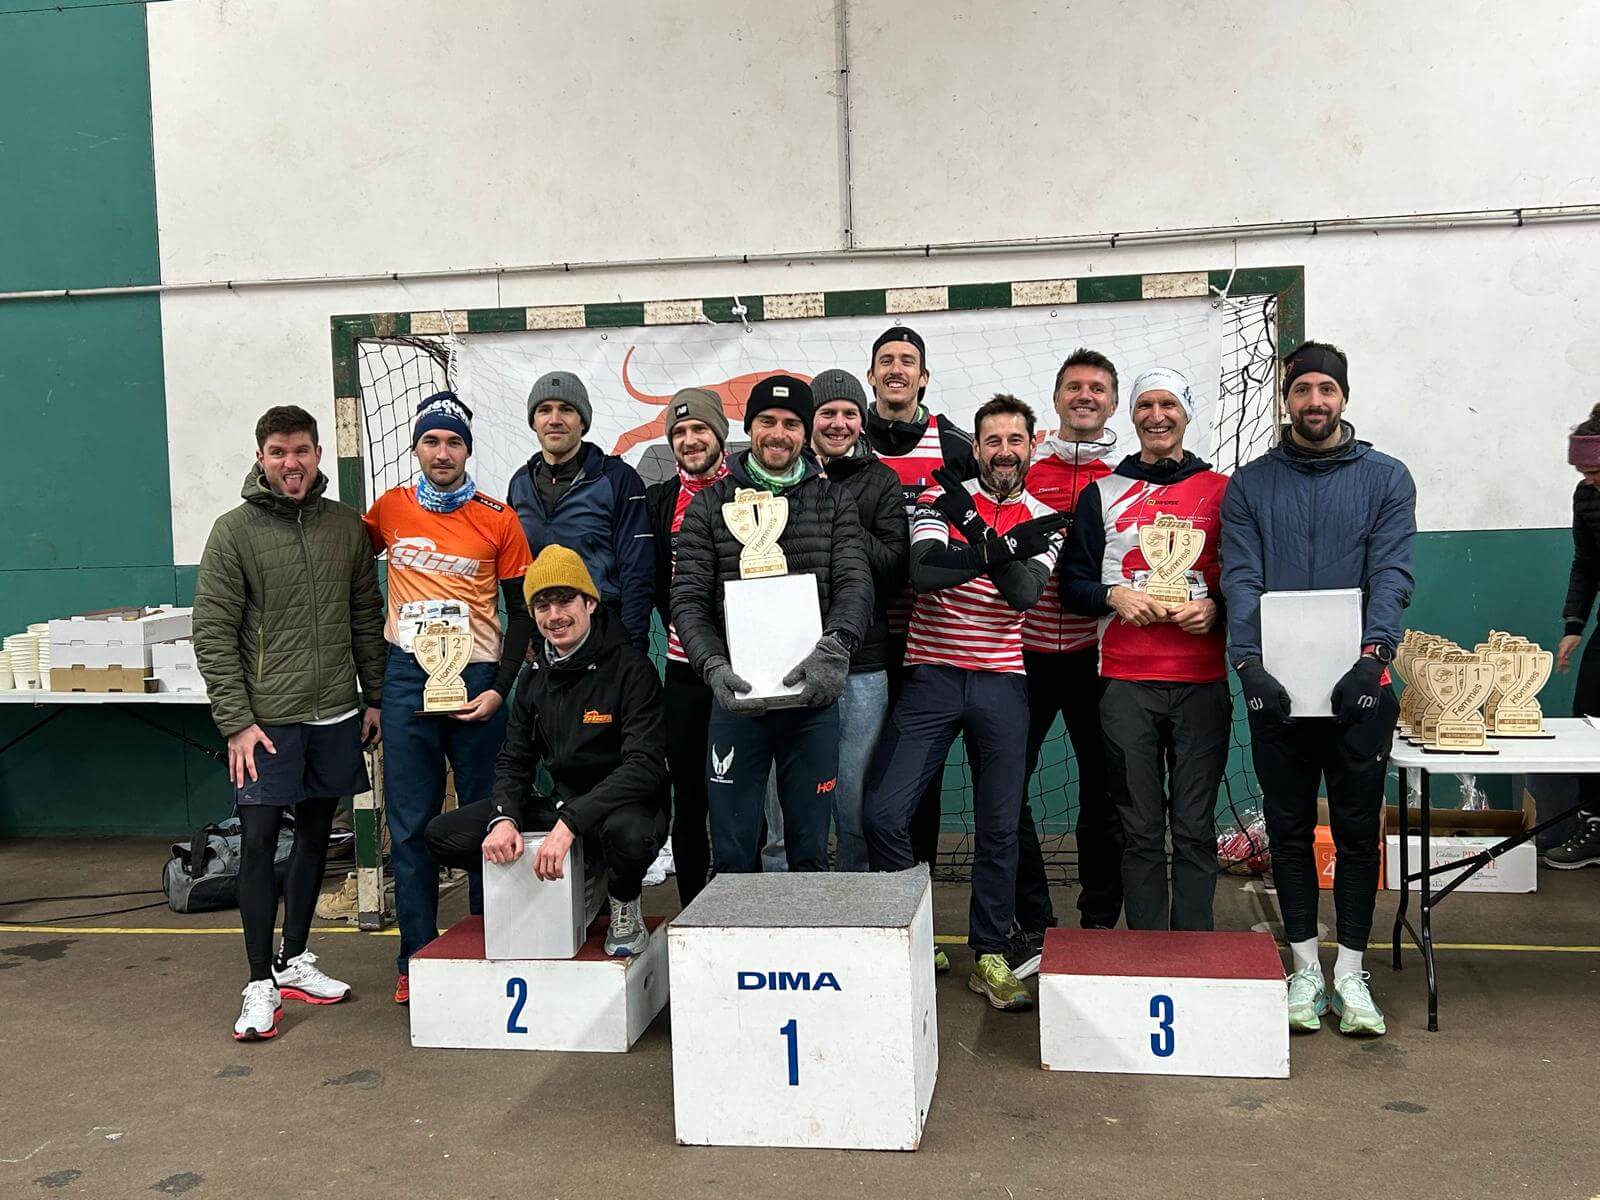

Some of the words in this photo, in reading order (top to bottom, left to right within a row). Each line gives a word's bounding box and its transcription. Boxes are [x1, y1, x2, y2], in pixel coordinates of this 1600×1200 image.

[1451, 682, 1483, 717] Femmes
[1509, 671, 1540, 705] Hommes
[737, 971, 842, 992] DIMA
[506, 977, 528, 1034] 2
[1150, 994, 1175, 1058] 3
[780, 1019, 799, 1086] 1
